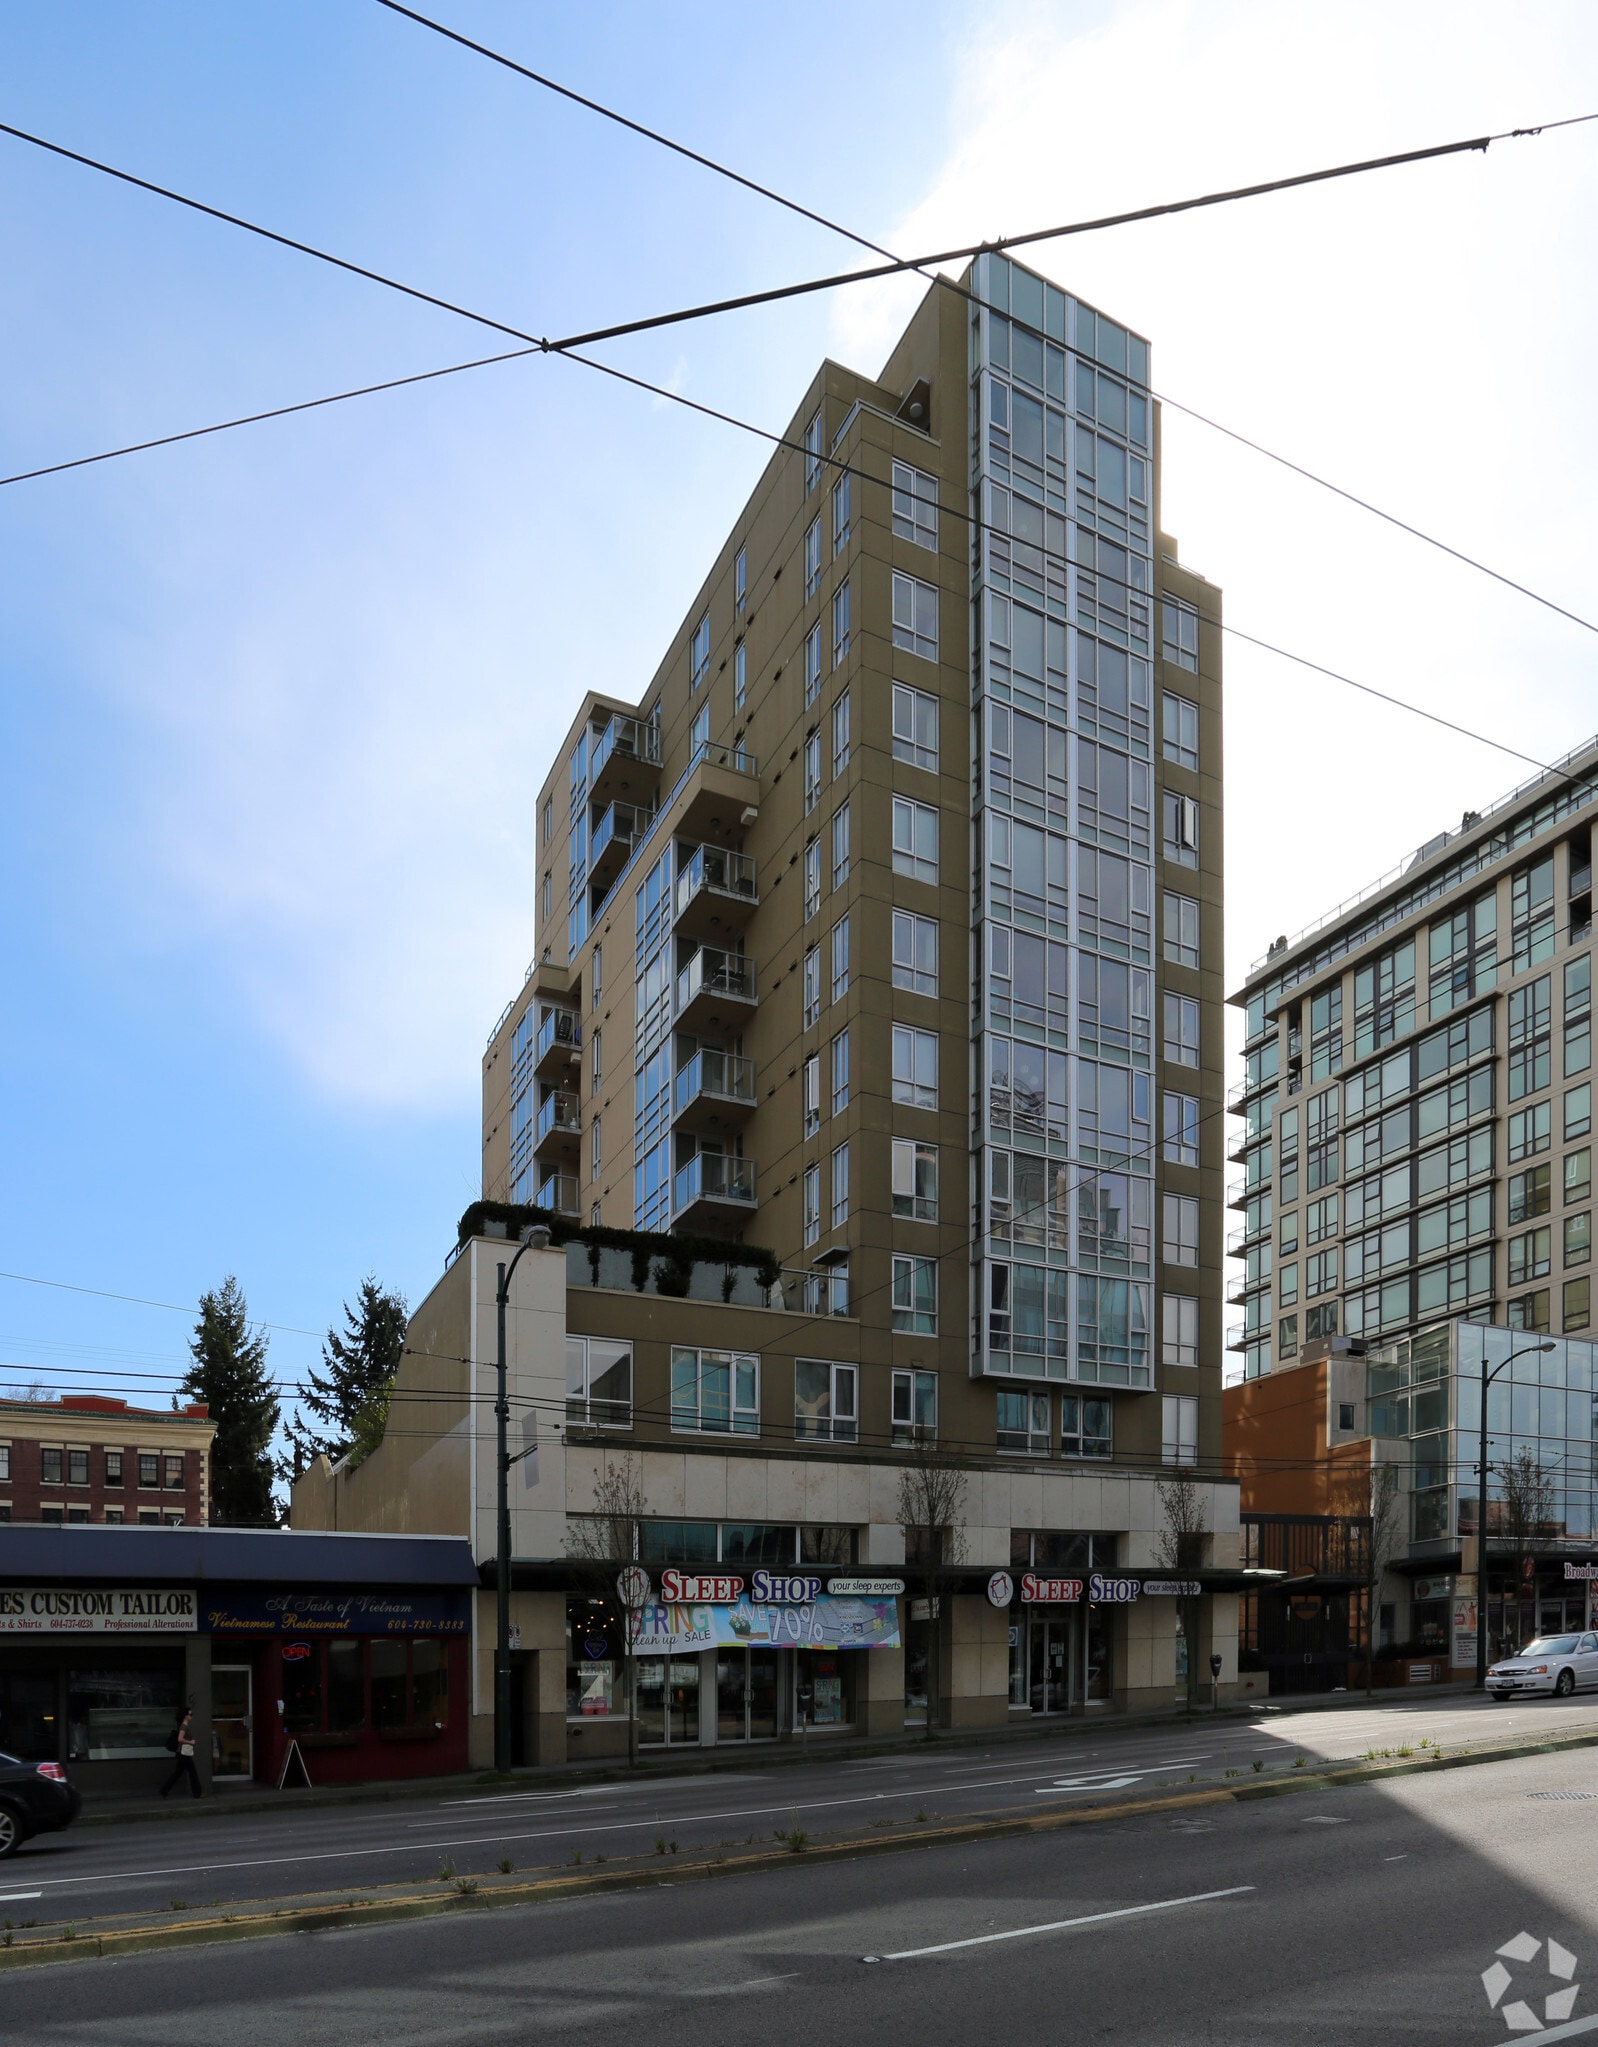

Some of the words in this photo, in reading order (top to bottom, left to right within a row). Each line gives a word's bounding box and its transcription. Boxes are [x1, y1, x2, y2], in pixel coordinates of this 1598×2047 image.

[1565, 1563, 1598, 1578] Broadw
[662, 1570, 743, 1601] SLEEP
[753, 1571, 820, 1601] SHOP
[832, 1582, 851, 1592] your
[852, 1580, 872, 1593] sleep
[874, 1581, 901, 1593] experts
[1022, 1574, 1082, 1601] SLEEP
[1090, 1575, 1140, 1601] SHOP
[1147, 1584, 1160, 1594] your
[31, 1593, 114, 1616] CUSTOM
[120, 1593, 192, 1616] TAILOR
[265, 1597, 289, 1612] A
[295, 1596, 334, 1612] Taste
[337, 1598, 352, 1618] of
[355, 1596, 413, 1613] Vietnam
[728, 1603, 768, 1622] SAVE
[8, 1618, 15, 1629] &
[17, 1618, 42, 1629] Shirts
[50, 1619, 93, 1629] 604-737-0238
[104, 1619, 151, 1630] Professional
[152, 1619, 193, 1629] Alterations
[209, 1611, 276, 1629] Vietnamese
[281, 1612, 350, 1629] Restaurant
[387, 1619, 465, 1630] 604-730-8383
[630, 1604, 710, 1635] SPRING
[768, 1605, 824, 1641] 70%
[662, 1636, 678, 1649] up
[685, 1630, 711, 1642] SALE
[281, 1646, 310, 1658] OPEN
